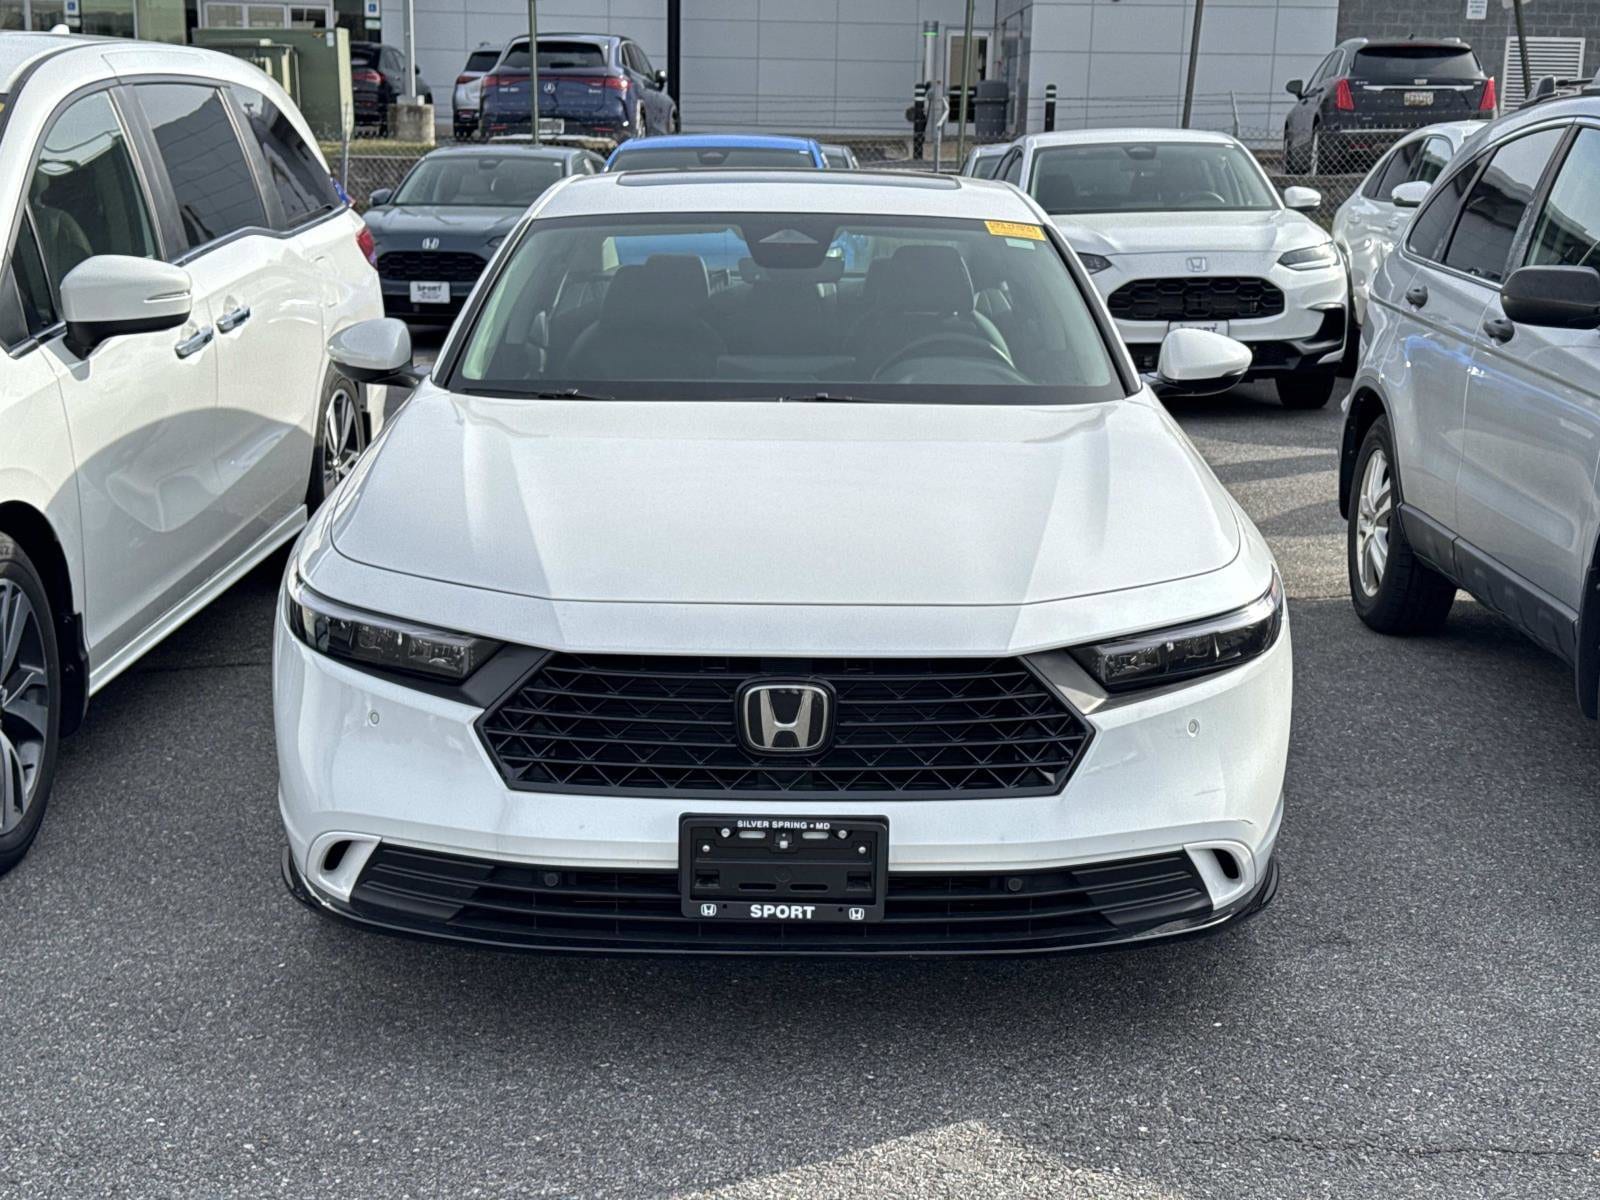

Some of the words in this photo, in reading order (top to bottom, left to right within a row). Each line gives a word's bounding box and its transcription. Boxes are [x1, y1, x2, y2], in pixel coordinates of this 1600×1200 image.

[737, 820, 769, 828] SILVER
[772, 820, 807, 829] SPRING
[816, 822, 831, 830] MD
[750, 904, 816, 920] SPORT
